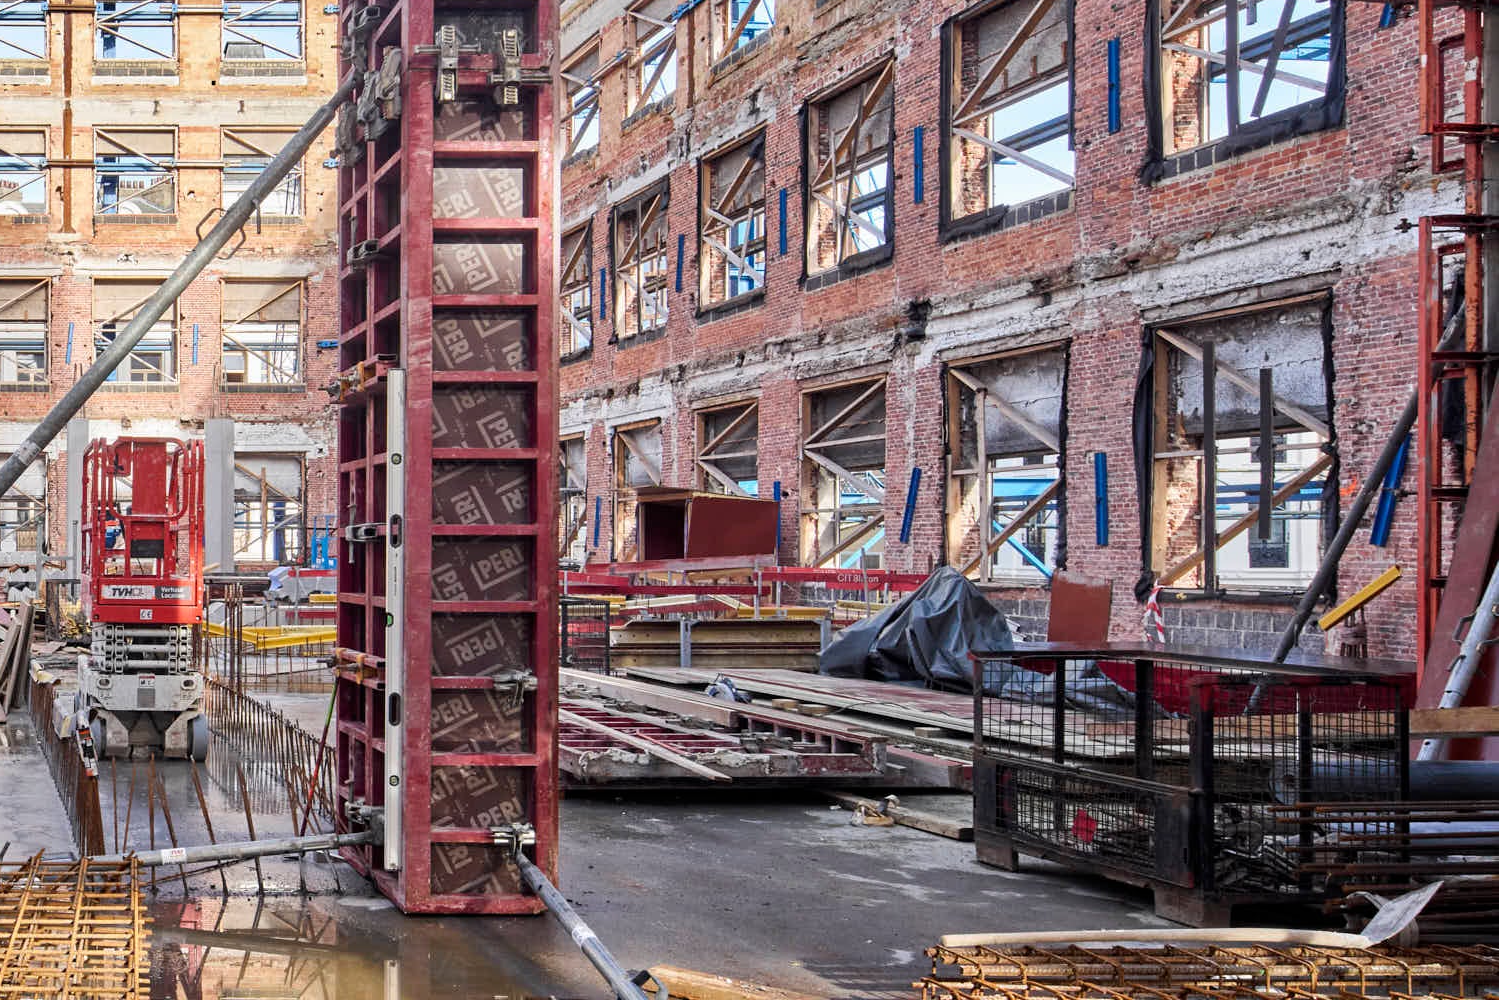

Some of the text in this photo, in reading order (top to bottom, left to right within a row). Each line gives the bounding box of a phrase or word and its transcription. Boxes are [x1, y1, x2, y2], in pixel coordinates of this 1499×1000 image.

[454, 244, 488, 285] PER
[437, 318, 474, 363] PERI
[451, 490, 481, 525] ERI
[477, 544, 524, 580] PERI
[112, 587, 132, 597] TVH
[451, 630, 497, 667] PERI
[477, 797, 524, 828] PERI
